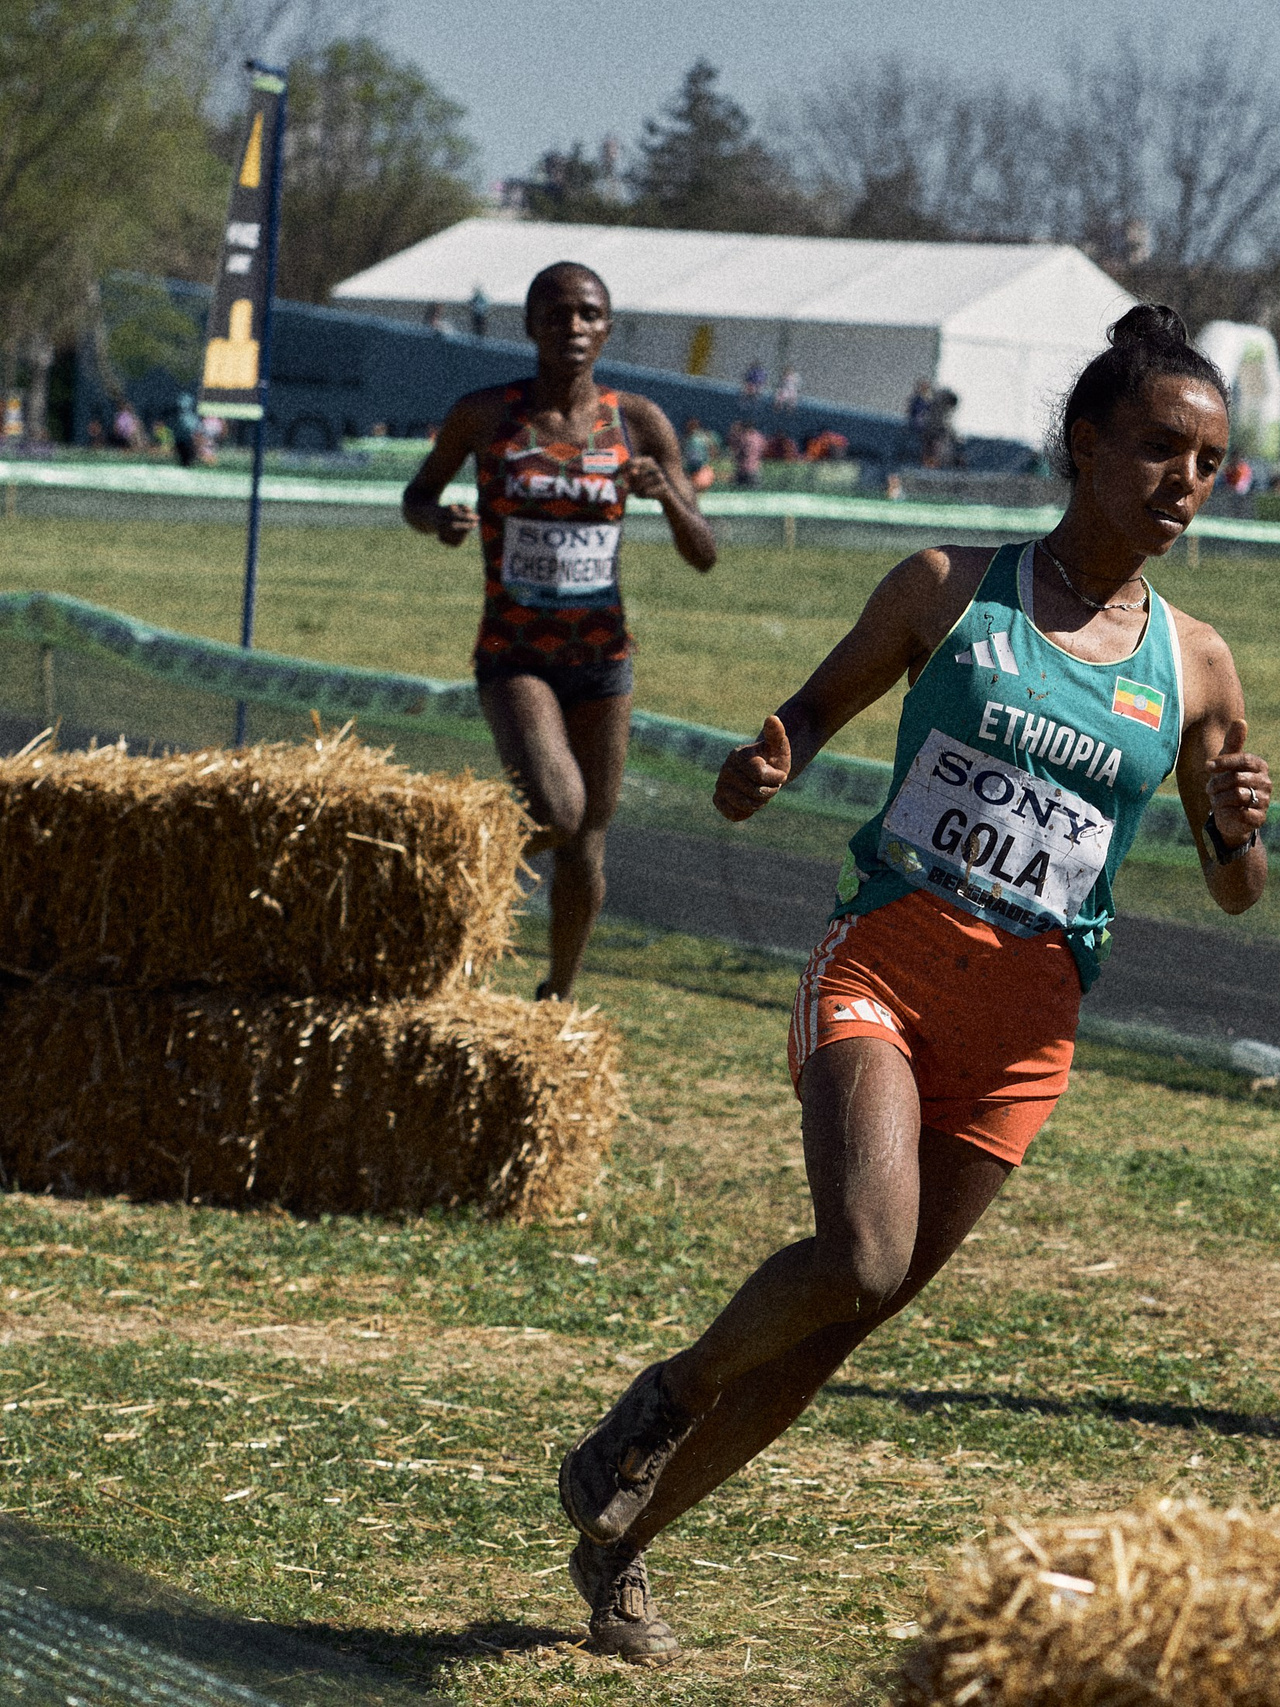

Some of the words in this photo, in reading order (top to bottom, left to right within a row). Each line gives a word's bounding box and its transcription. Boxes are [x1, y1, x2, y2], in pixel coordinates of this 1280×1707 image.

[505, 475, 618, 504] KENYA
[518, 526, 611, 548] SONY
[978, 700, 1122, 787] ETHIOPIA
[932, 751, 1098, 845] SONY
[931, 808, 1052, 897] GOLA
